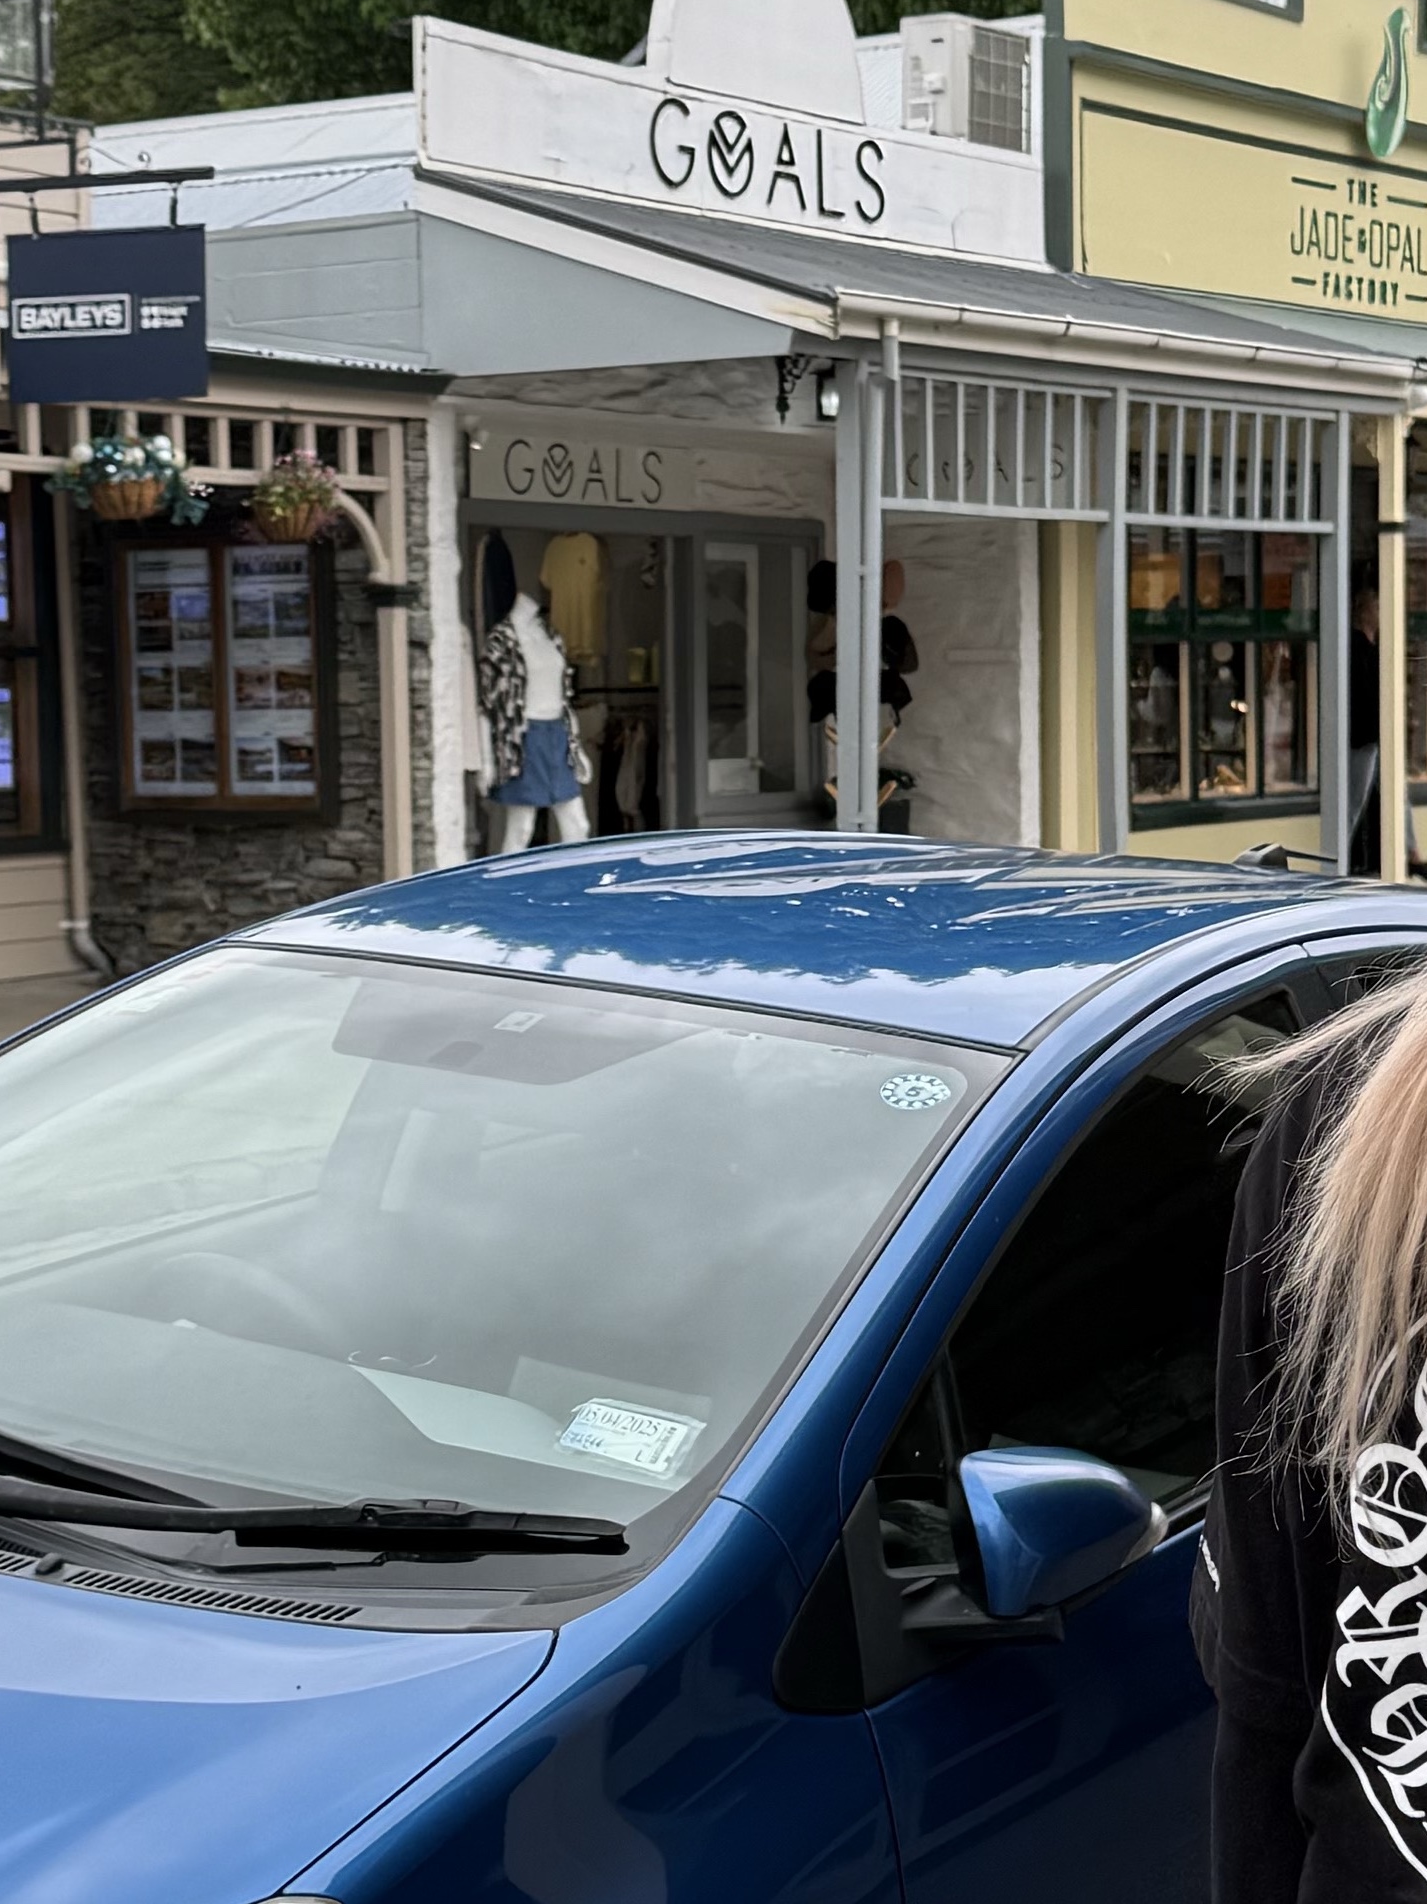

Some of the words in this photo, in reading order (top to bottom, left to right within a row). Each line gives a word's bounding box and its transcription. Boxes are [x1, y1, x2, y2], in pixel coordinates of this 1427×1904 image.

[649, 97, 885, 224] GOALS
[1347, 178, 1378, 208] THE
[1322, 272, 1399, 306] FACTORY
[20, 302, 123, 331] BAYLEYS
[504, 438, 662, 505] GOALS
